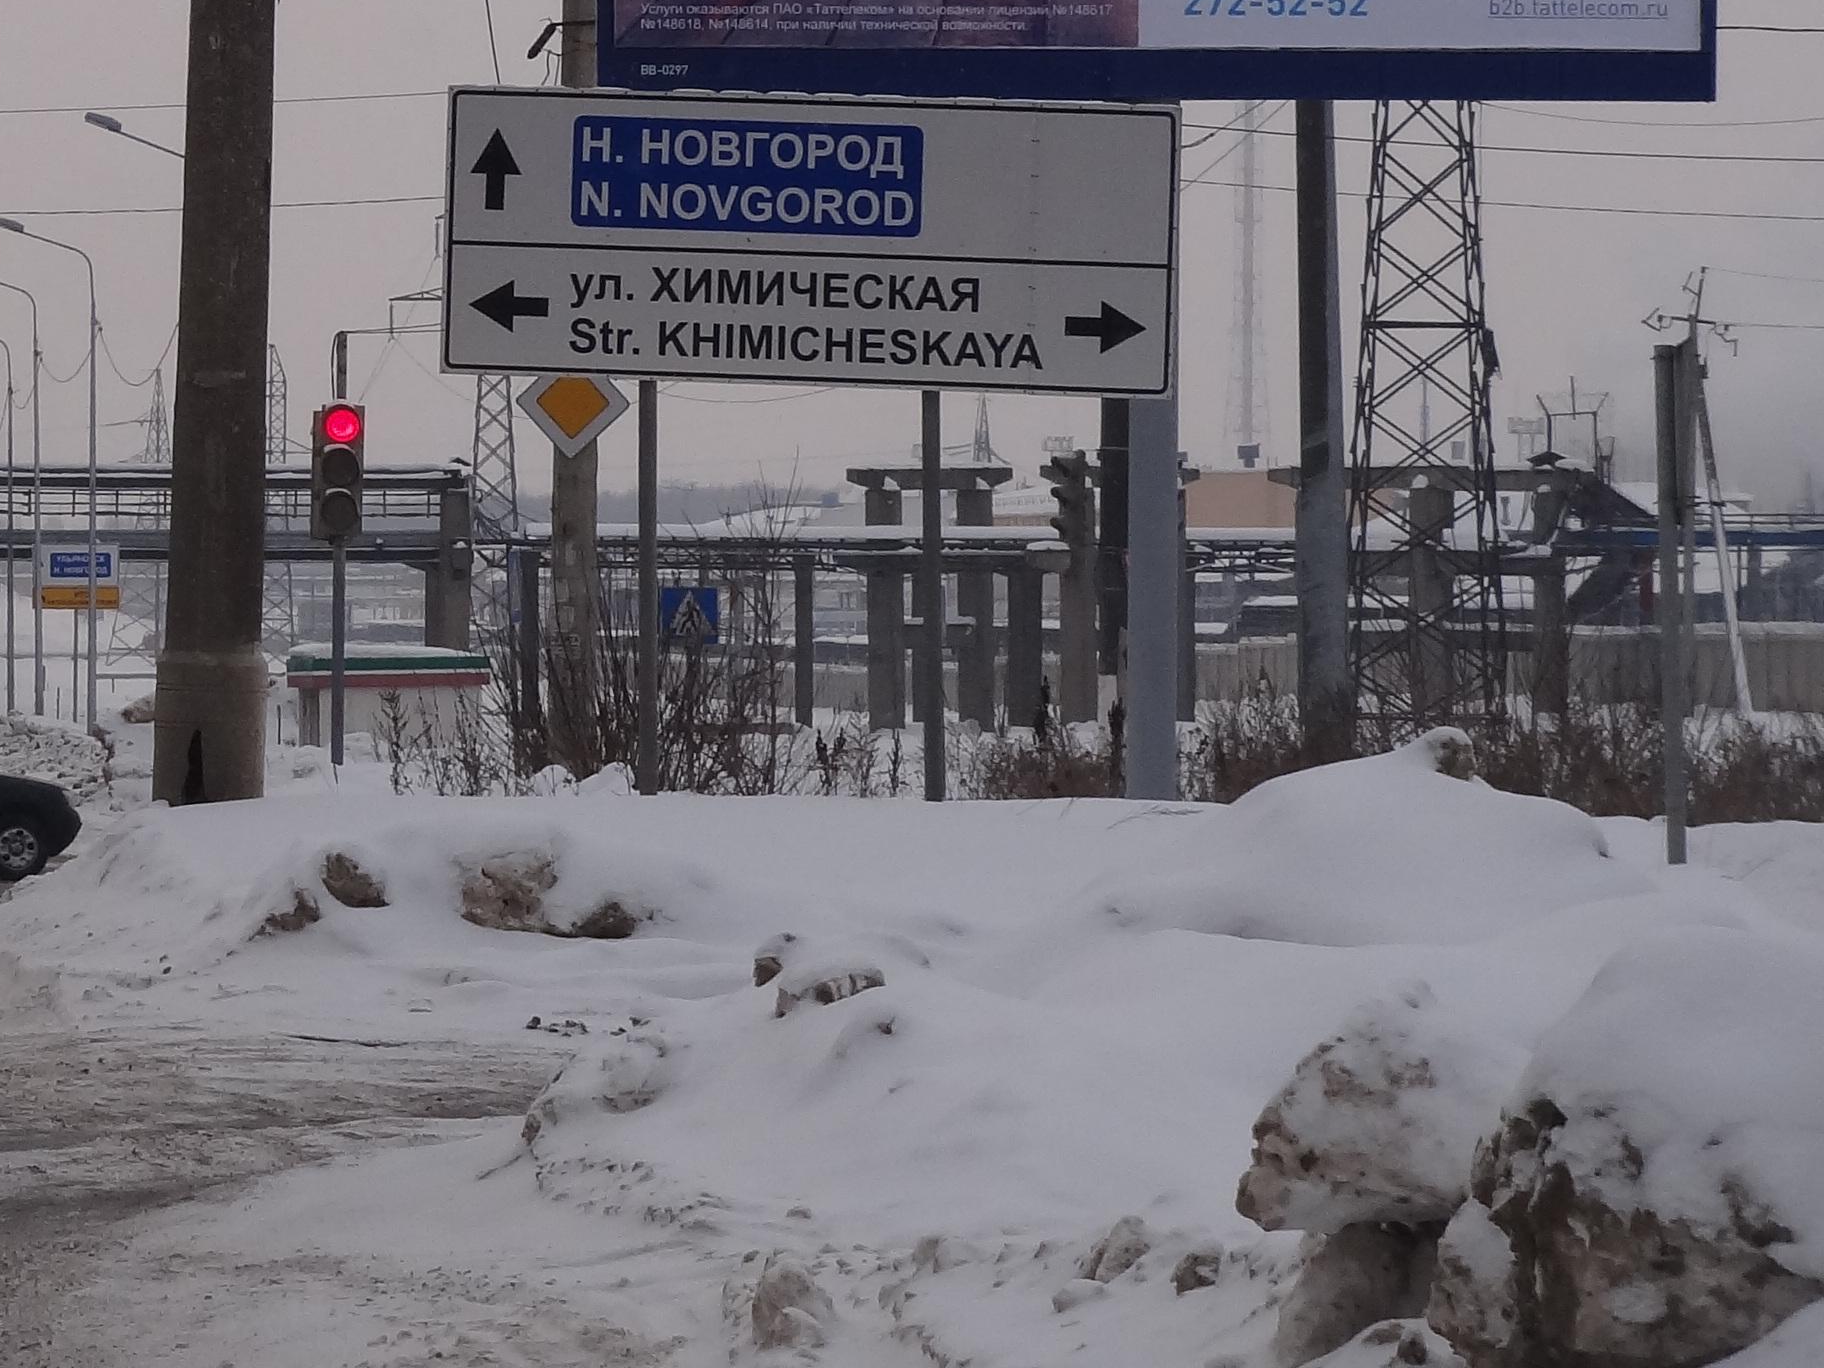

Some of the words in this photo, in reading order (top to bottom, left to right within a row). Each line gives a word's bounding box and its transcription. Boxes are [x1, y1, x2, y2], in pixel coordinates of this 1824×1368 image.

[640, 3, 684, 16] Услуги
[686, 5, 769, 15] оказываются
[773, 3, 802, 15] ПАО
[898, 6, 914, 16] на
[776, 20, 799, 33] при
[802, 20, 857, 31] наличии
[581, 126, 624, 164] Н.
[640, 129, 905, 180] НОВГОРОД
[579, 181, 622, 218] N.
[639, 183, 914, 227] NOVGOROD
[570, 272, 635, 309] ул.
[649, 266, 982, 313] ХИМИЧЕСКАЯ
[568, 317, 640, 355] Str.
[657, 320, 1044, 371] KHIMICHESKAYA
